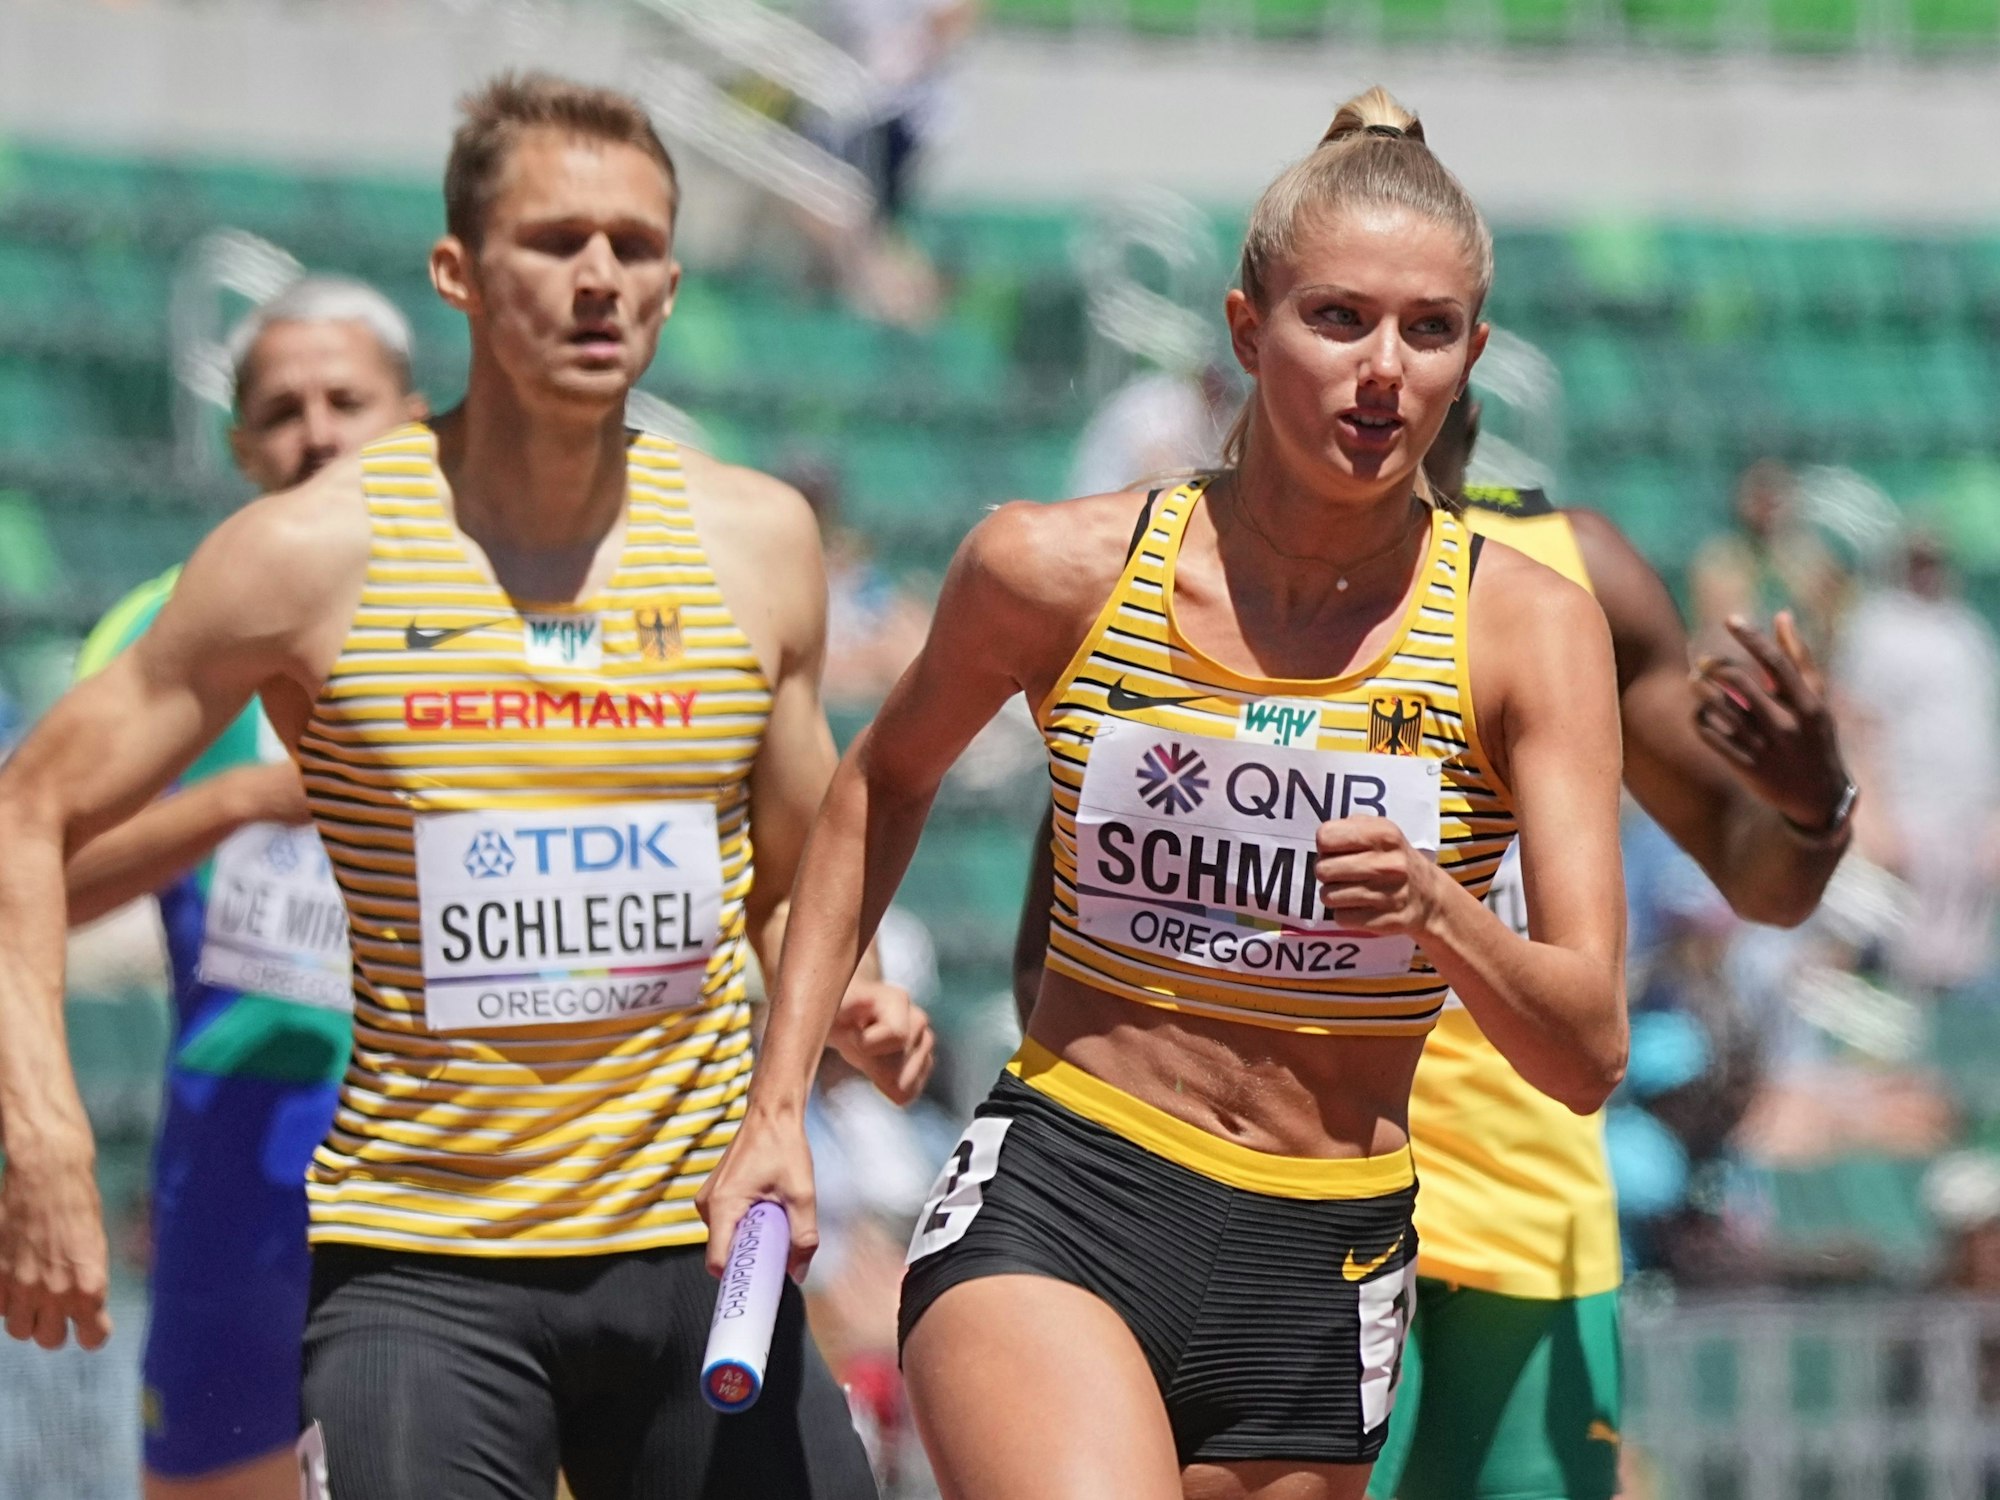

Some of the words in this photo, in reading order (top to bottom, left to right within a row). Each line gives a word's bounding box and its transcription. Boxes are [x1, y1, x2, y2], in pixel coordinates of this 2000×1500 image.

[404, 690, 698, 730] GERMANY
[1226, 763, 1387, 822] QNB
[516, 822, 678, 875] TDK
[1098, 822, 1334, 921] SCHMI
[441, 893, 703, 963] SCHLEGEL
[1130, 911, 1361, 972] OREGON22
[478, 982, 668, 1020] OREGON22
[724, 1209, 765, 1319] CHAMPIONSHIPS
